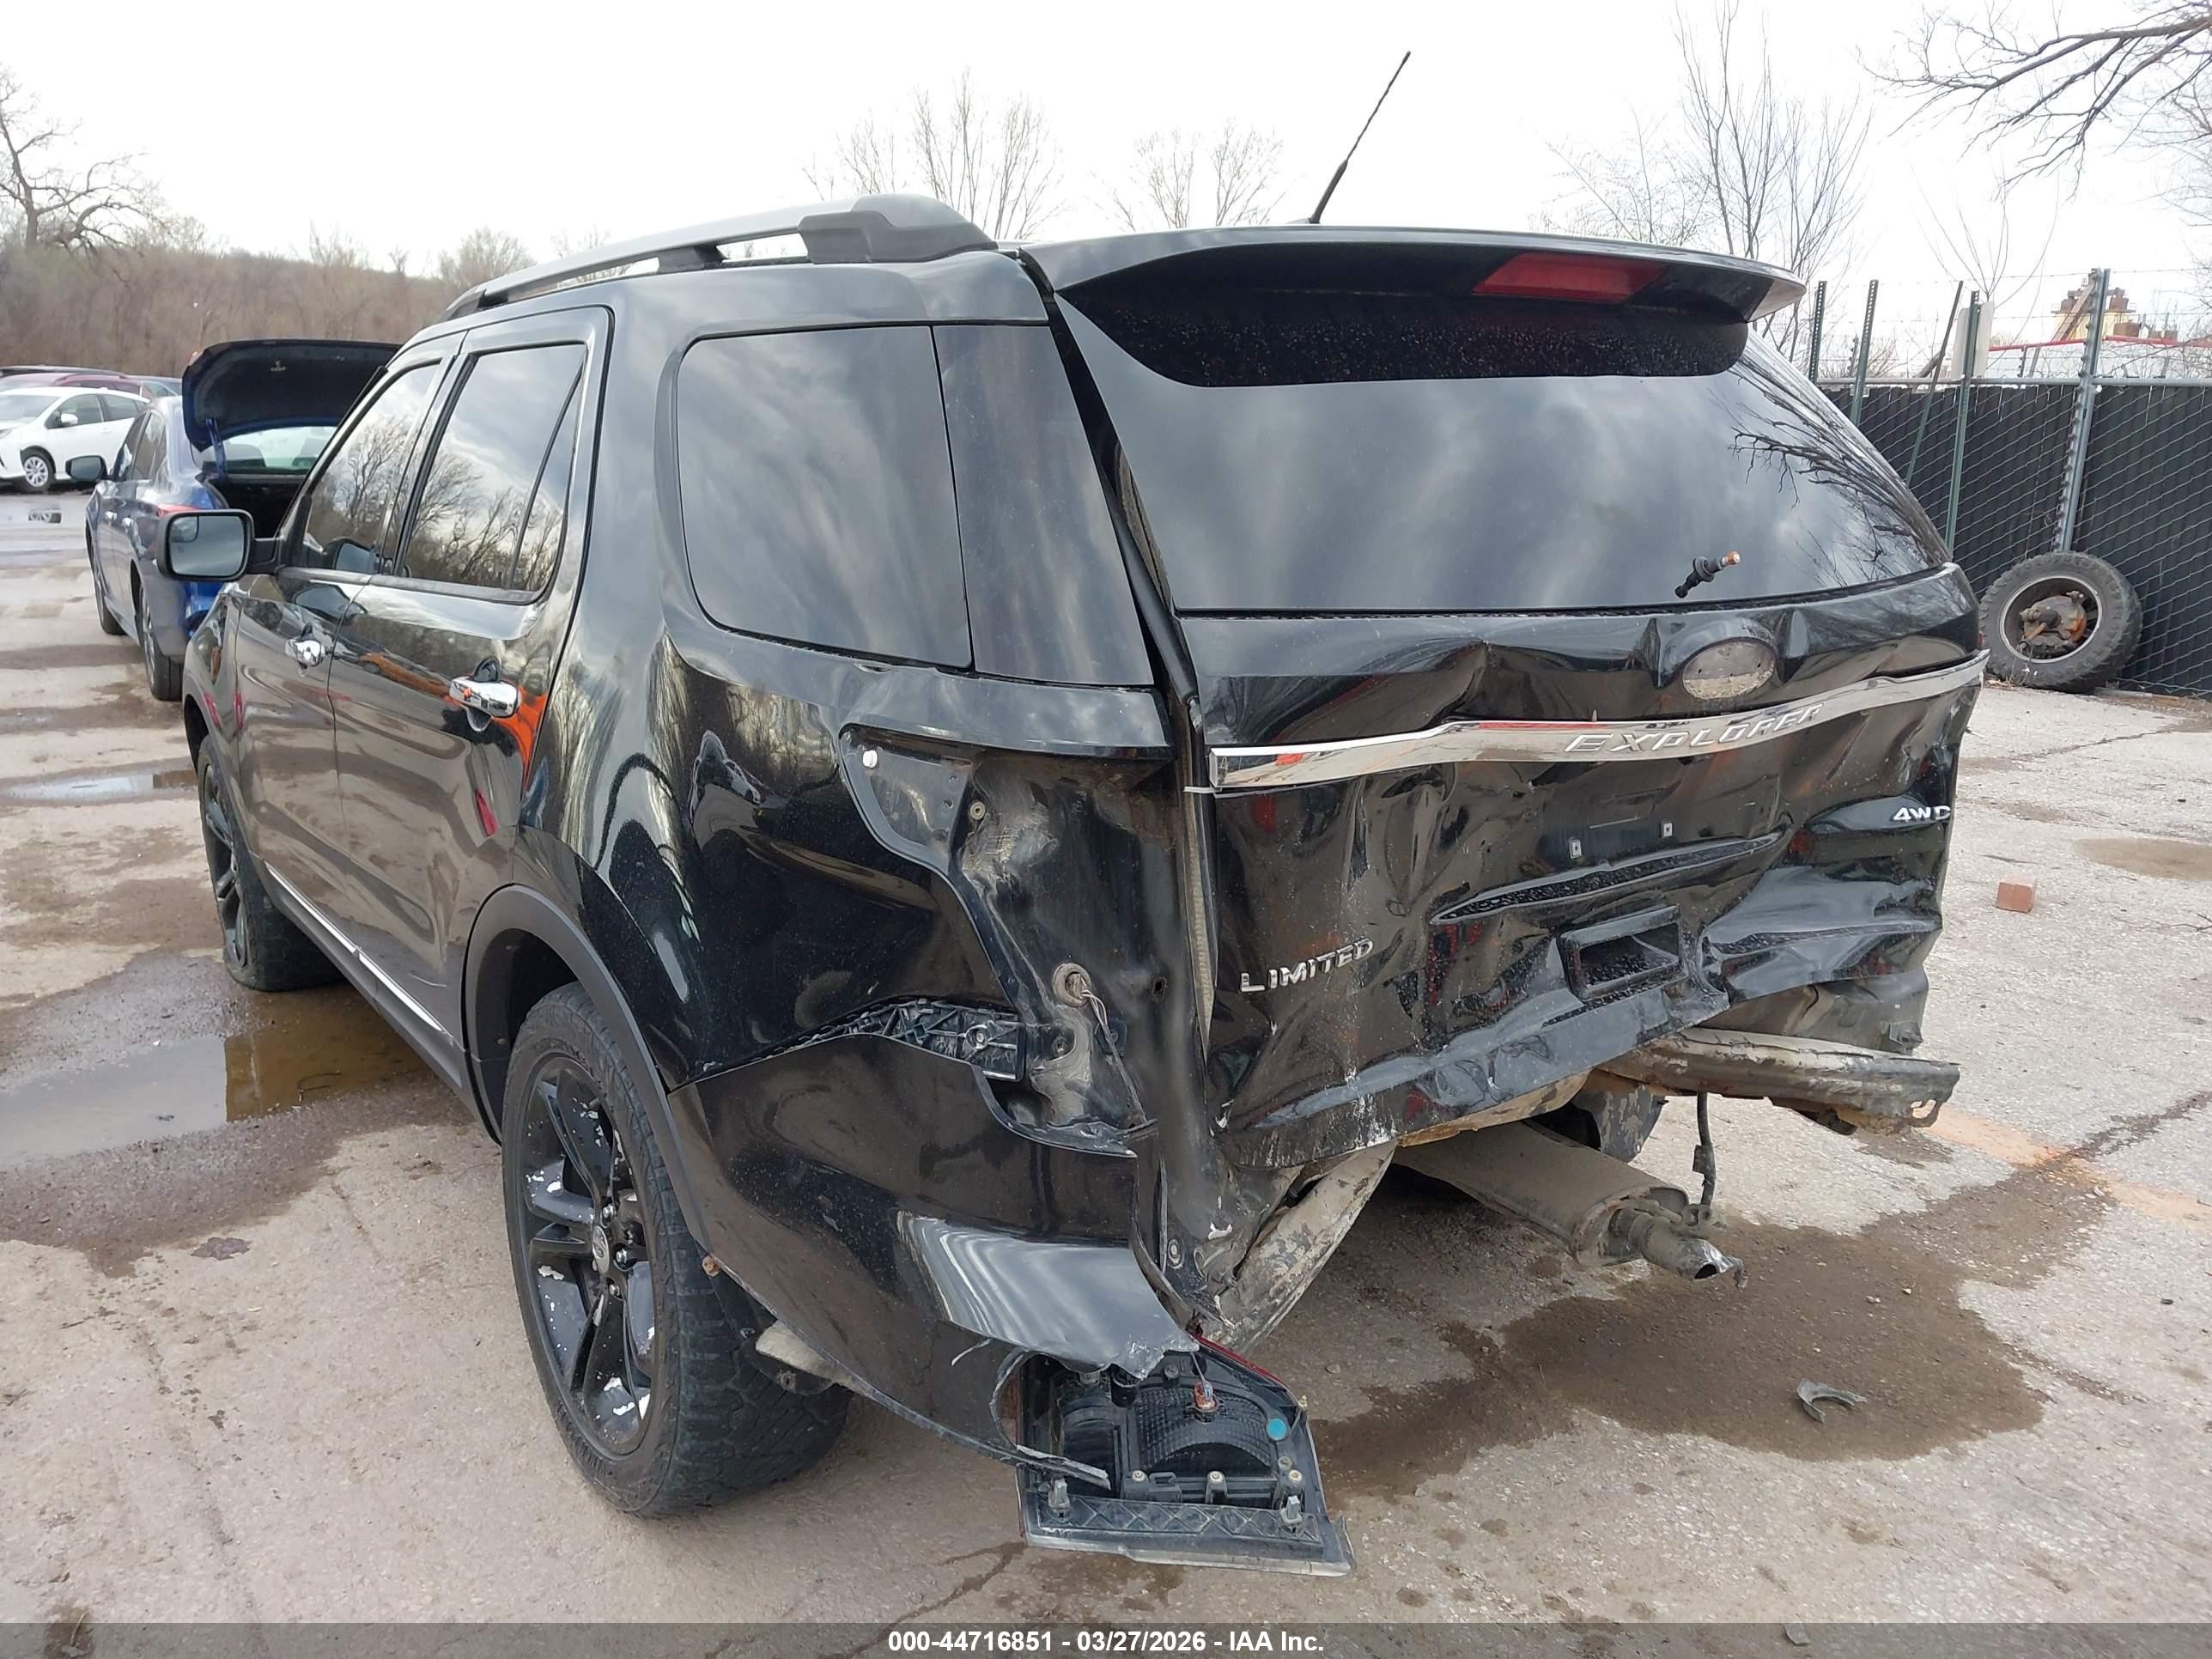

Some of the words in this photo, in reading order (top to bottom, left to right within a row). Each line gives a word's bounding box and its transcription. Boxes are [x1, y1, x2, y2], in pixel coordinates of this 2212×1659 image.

[1564, 702, 1825, 753] EXPLORER
[1893, 805, 1952, 823] 4WD
[1240, 937, 1374, 994] LIMITED
